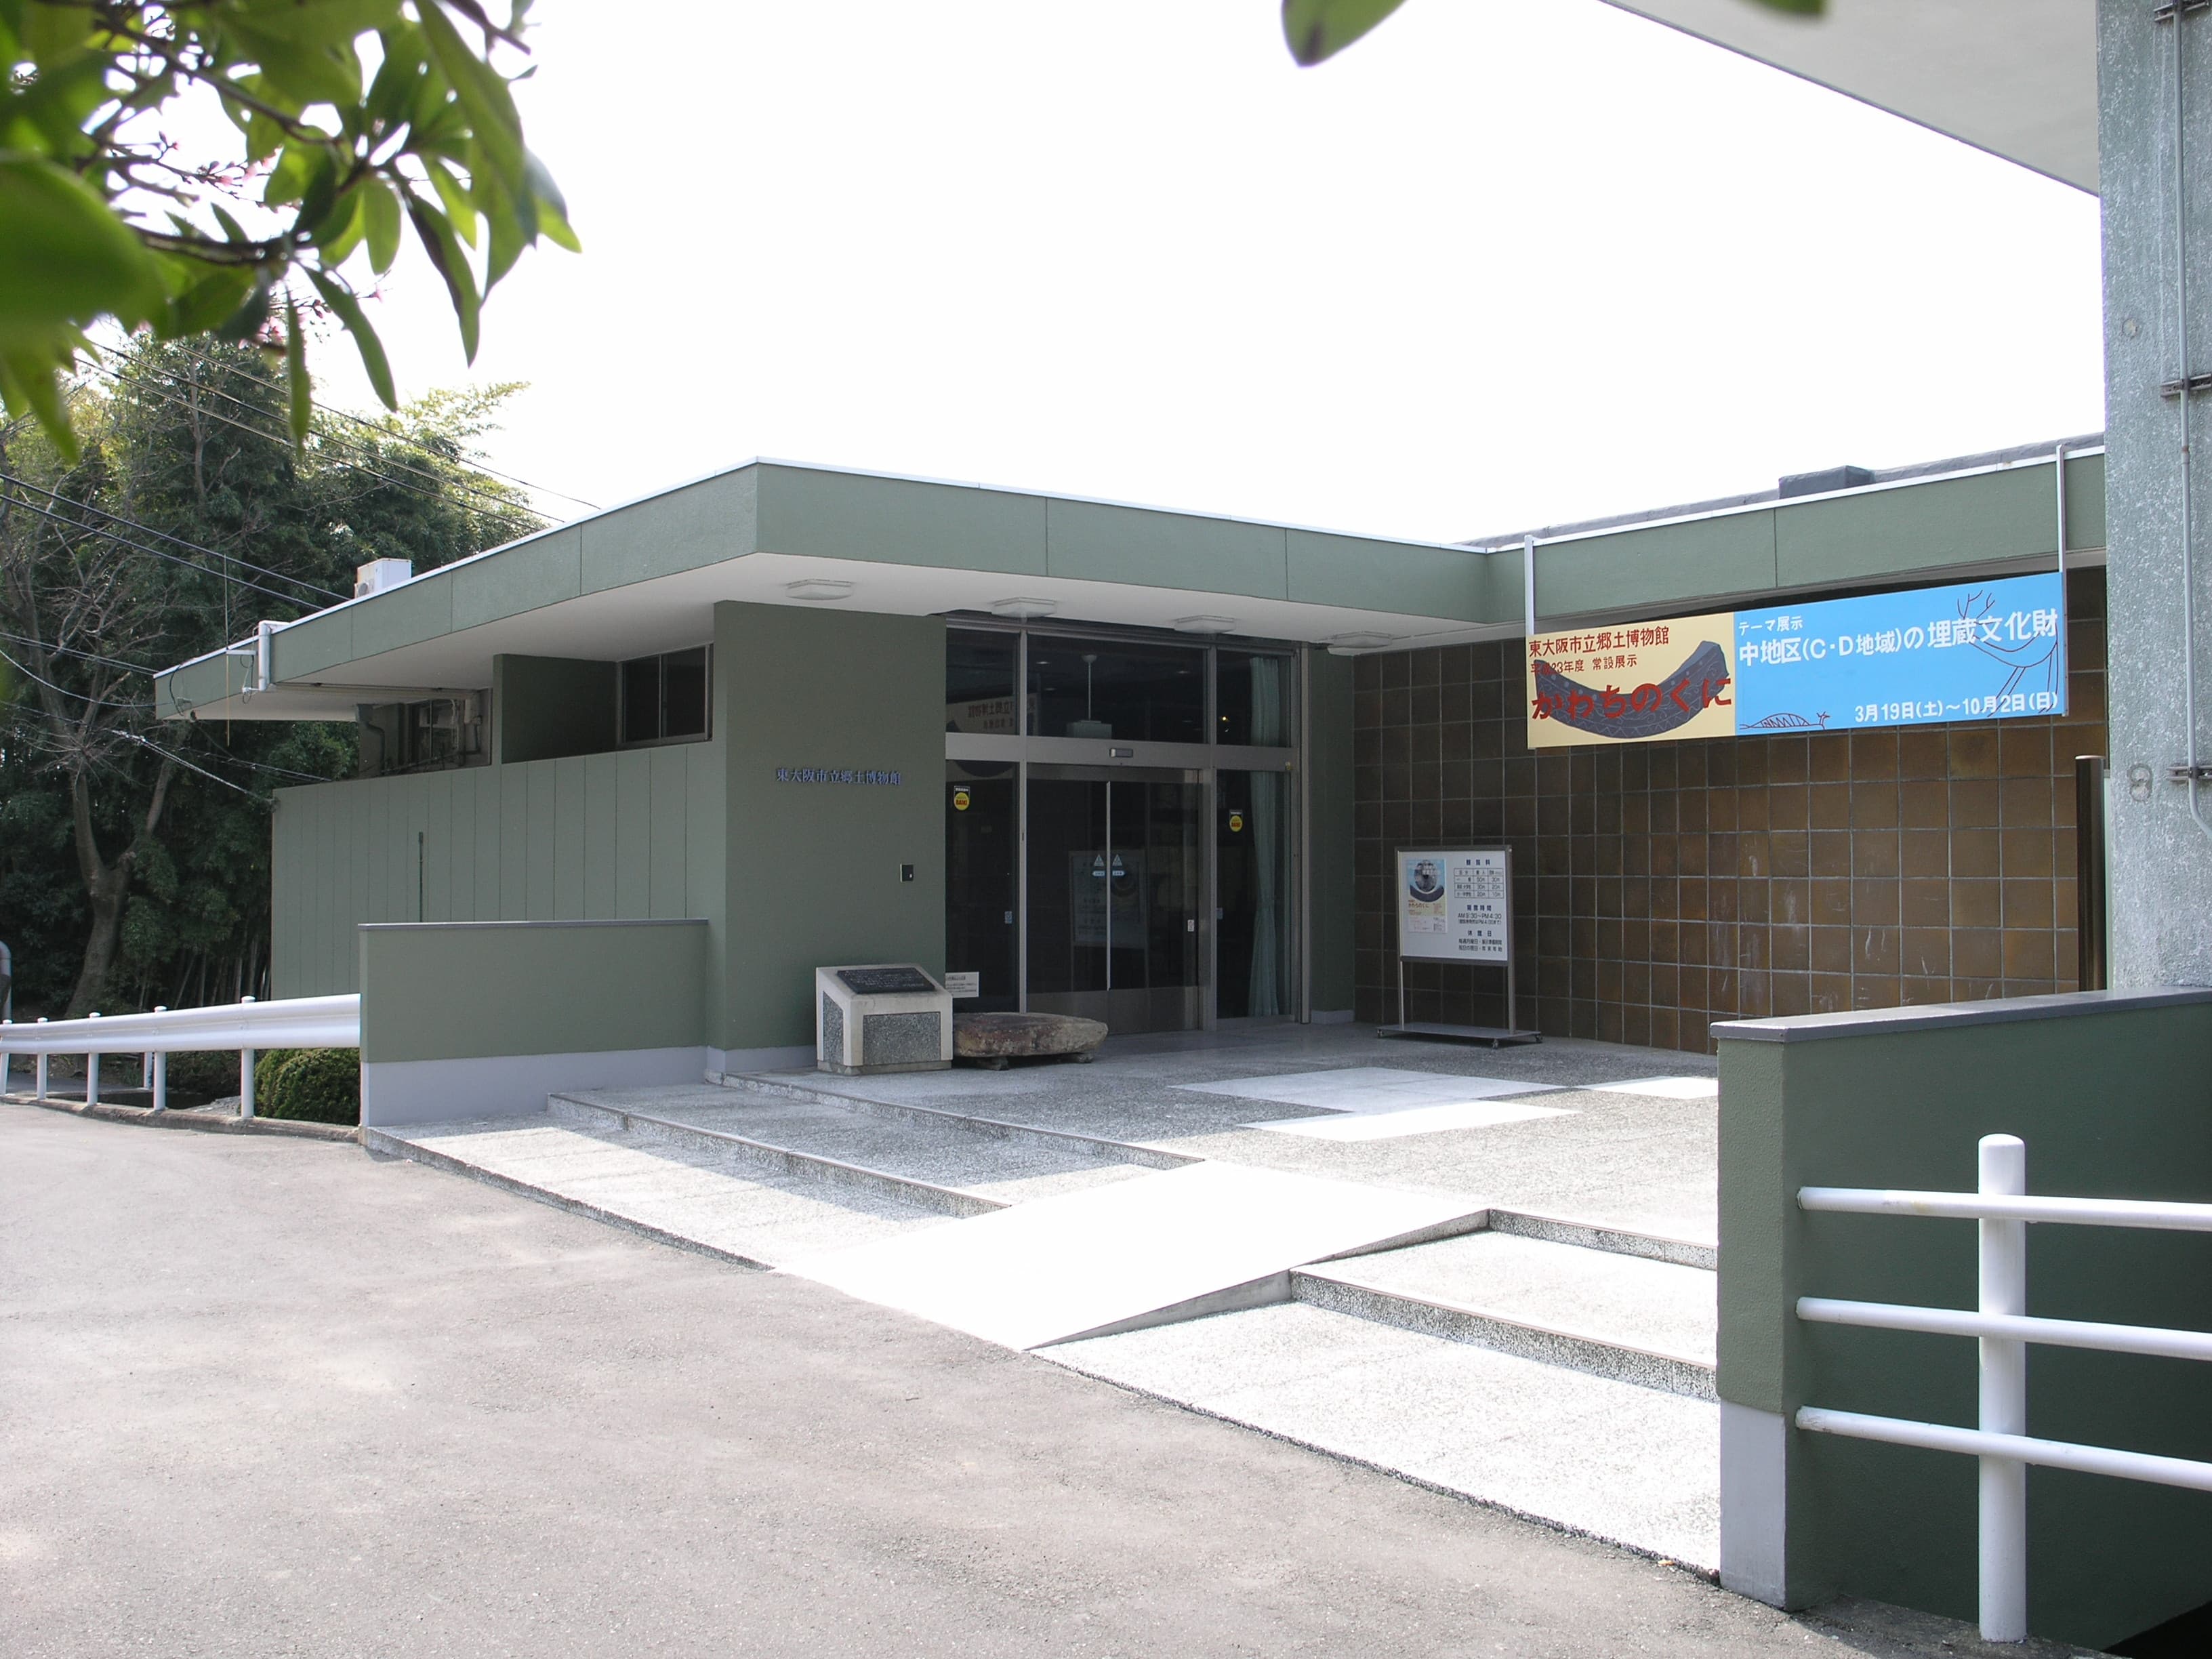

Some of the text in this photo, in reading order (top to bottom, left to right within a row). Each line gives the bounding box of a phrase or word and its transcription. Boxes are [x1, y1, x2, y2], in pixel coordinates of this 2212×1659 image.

[1738, 615, 1803, 636] テーマ展示
[1529, 626, 1669, 657] 東大阪市立郷土博物館
[1592, 654, 1637, 670] 常設展示
[1531, 678, 1732, 720] かわちのくに
[776, 768, 901, 785] 東大阪市立郷土博物館
